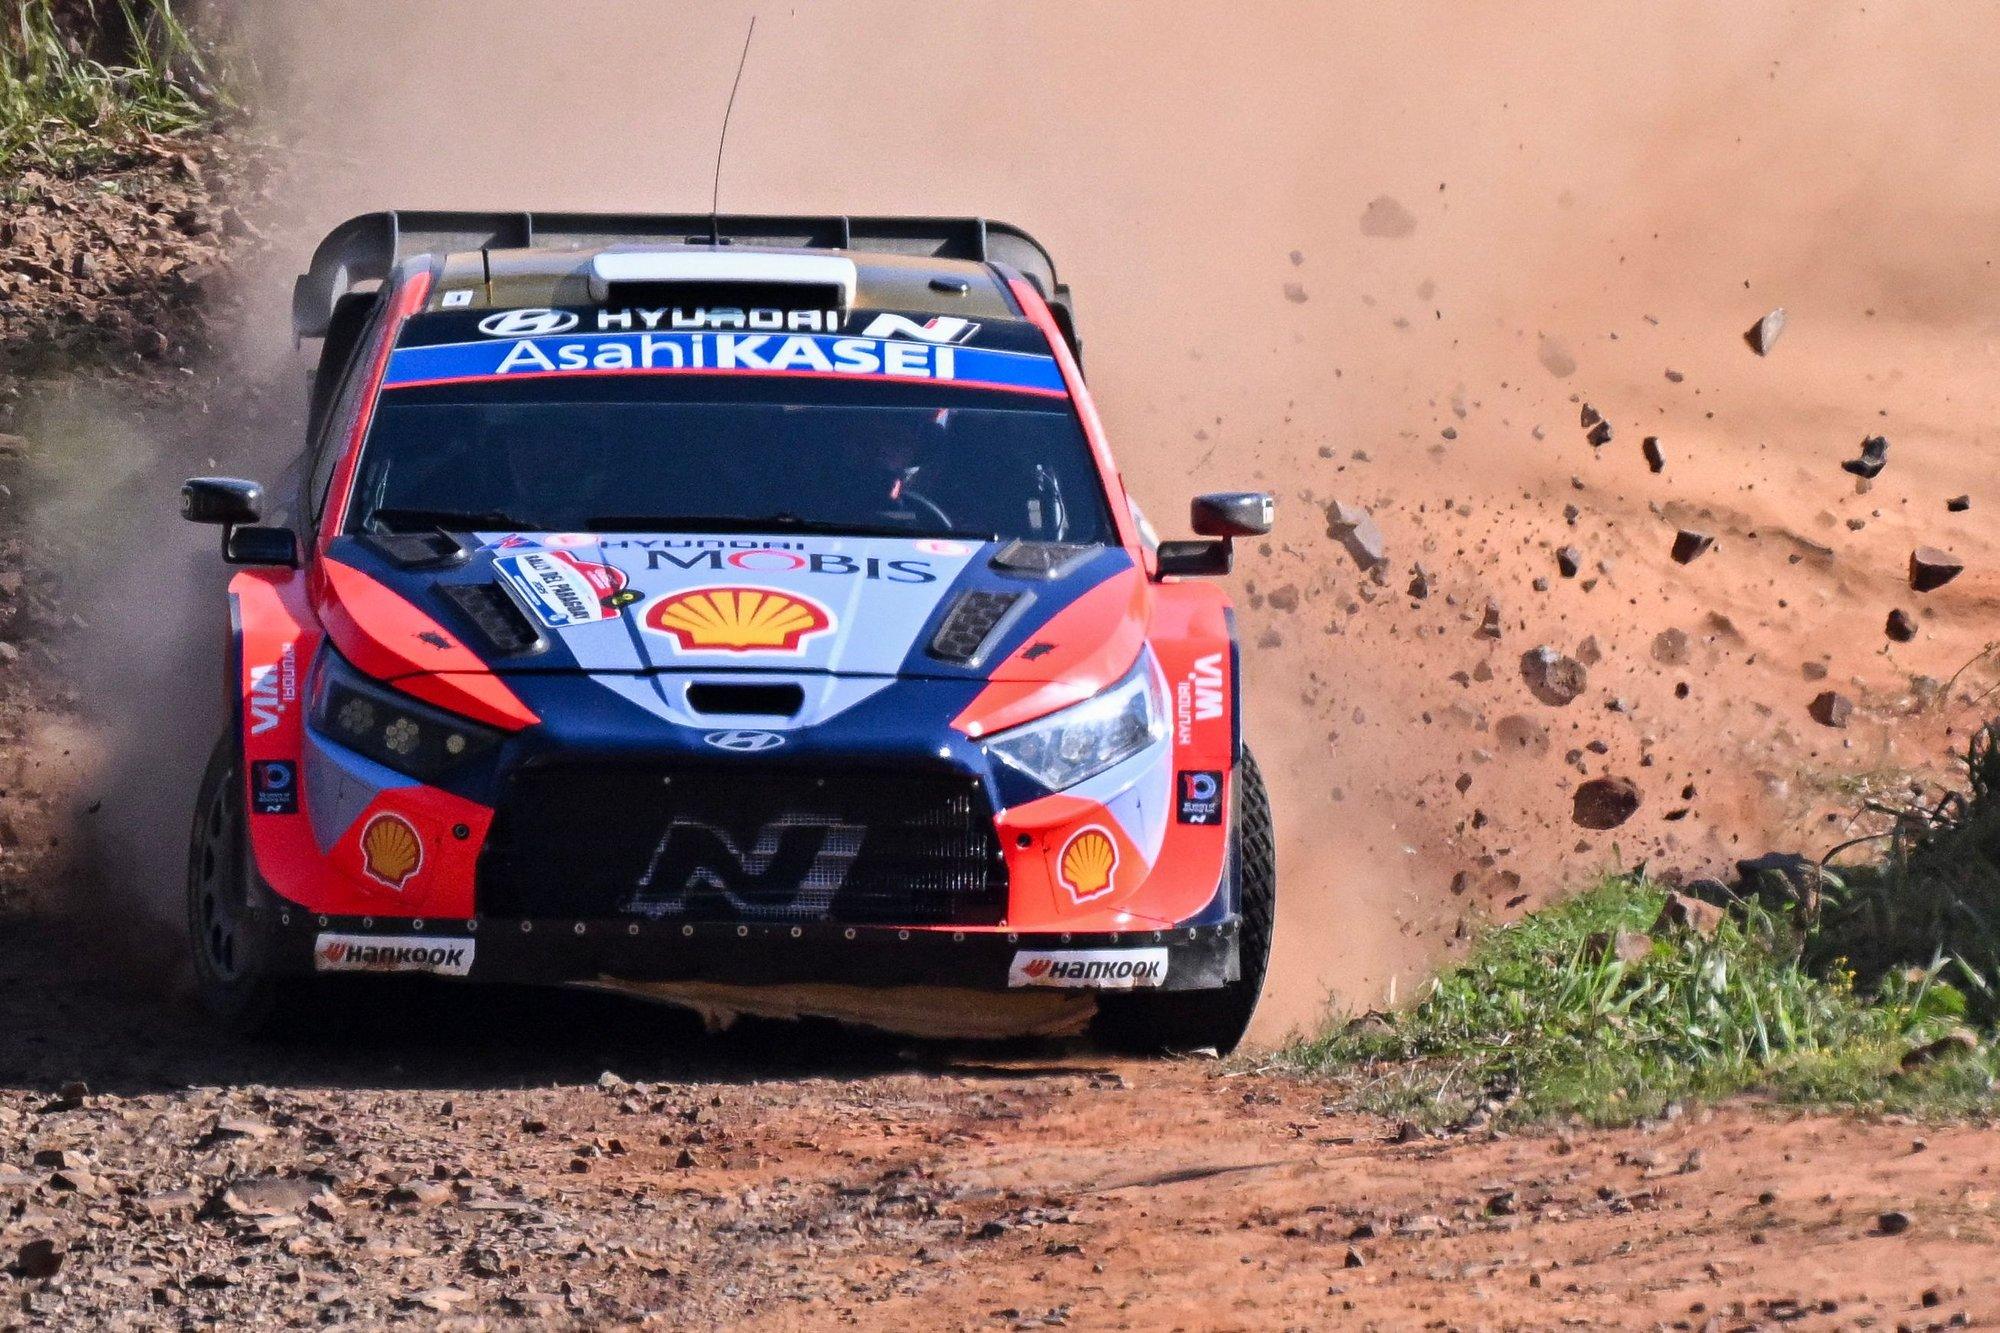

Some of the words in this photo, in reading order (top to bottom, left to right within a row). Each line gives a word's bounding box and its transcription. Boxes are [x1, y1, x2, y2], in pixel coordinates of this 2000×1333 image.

[597, 307, 838, 333] HYUNDAI
[601, 539, 804, 551] HYUNDAI
[647, 550, 937, 584] MOBIS
[1178, 681, 1192, 746] HYUNDAI
